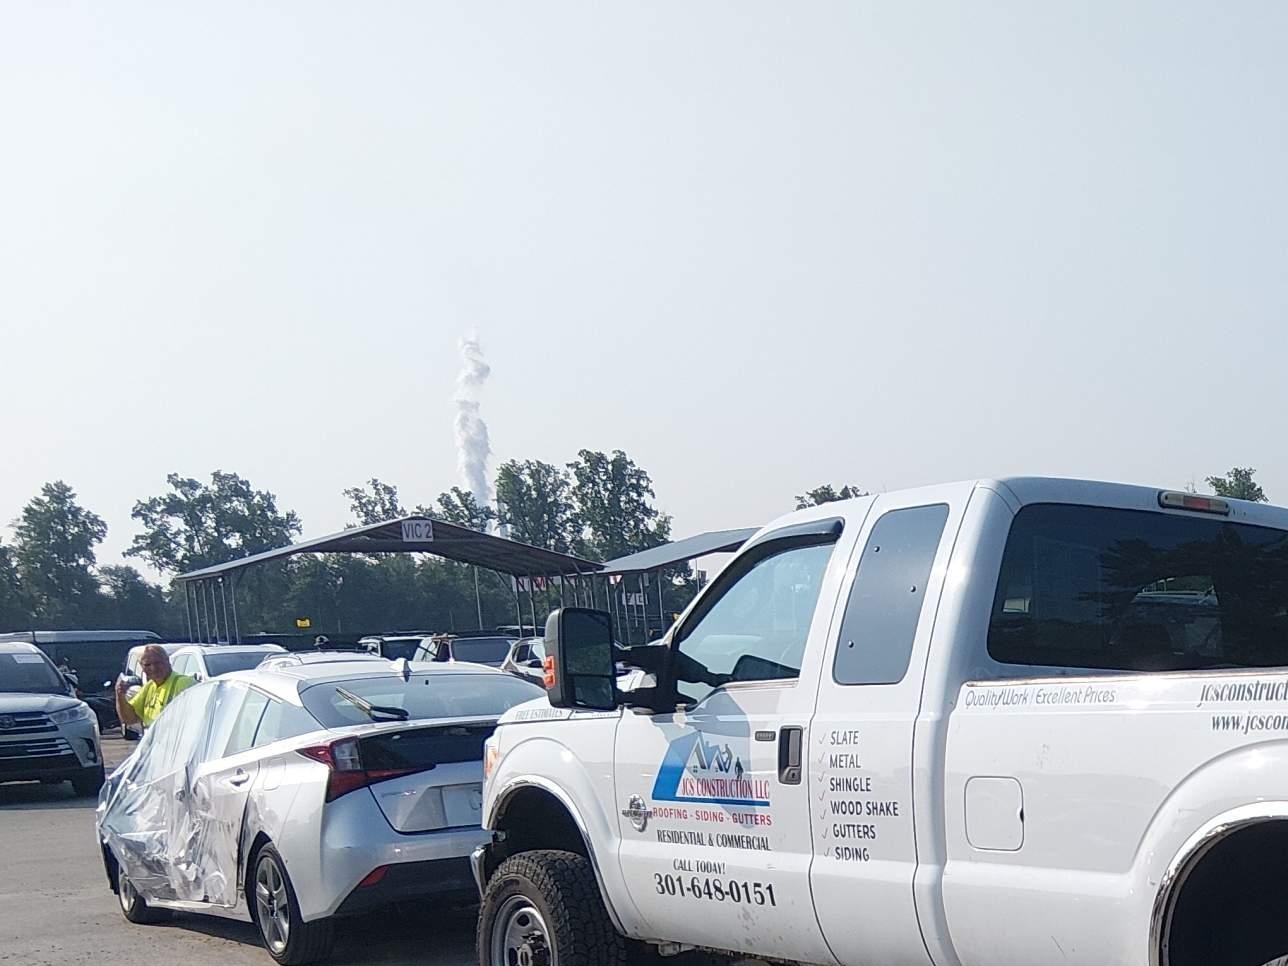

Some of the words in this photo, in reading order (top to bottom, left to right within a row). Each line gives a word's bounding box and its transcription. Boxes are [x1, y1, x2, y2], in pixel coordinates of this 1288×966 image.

[402, 523, 422, 539] VIC
[424, 523, 433, 539] 2
[965, 689, 1001, 710] Quality
[1000, 687, 1029, 706] Work
[1035, 687, 1084, 705] Excellent
[1084, 686, 1116, 704] Prices
[830, 730, 859, 746] SLATE
[829, 753, 861, 769] METAL
[681, 777, 695, 797] JCS
[696, 778, 753, 799] CONSTRUCTION
[755, 780, 770, 799] LLC
[829, 776, 872, 793] SHINGLE
[652, 807, 688, 820] ROOFING
[695, 809, 724, 823] SIDING
[732, 812, 772, 826] GUTTERS
[830, 800, 863, 816] WOOD
[866, 801, 899, 817] SHAKE
[657, 829, 706, 847] RESIDENTIAL
[709, 835, 714, 847] &
[716, 833, 772, 851] COMMERCIAL
[833, 823, 876, 840] GUTTERS
[835, 846, 870, 862] SIDING
[673, 858, 693, 872] CALL
[695, 859, 726, 875] TODAY!
[654, 872, 777, 907] 301-648-0151
